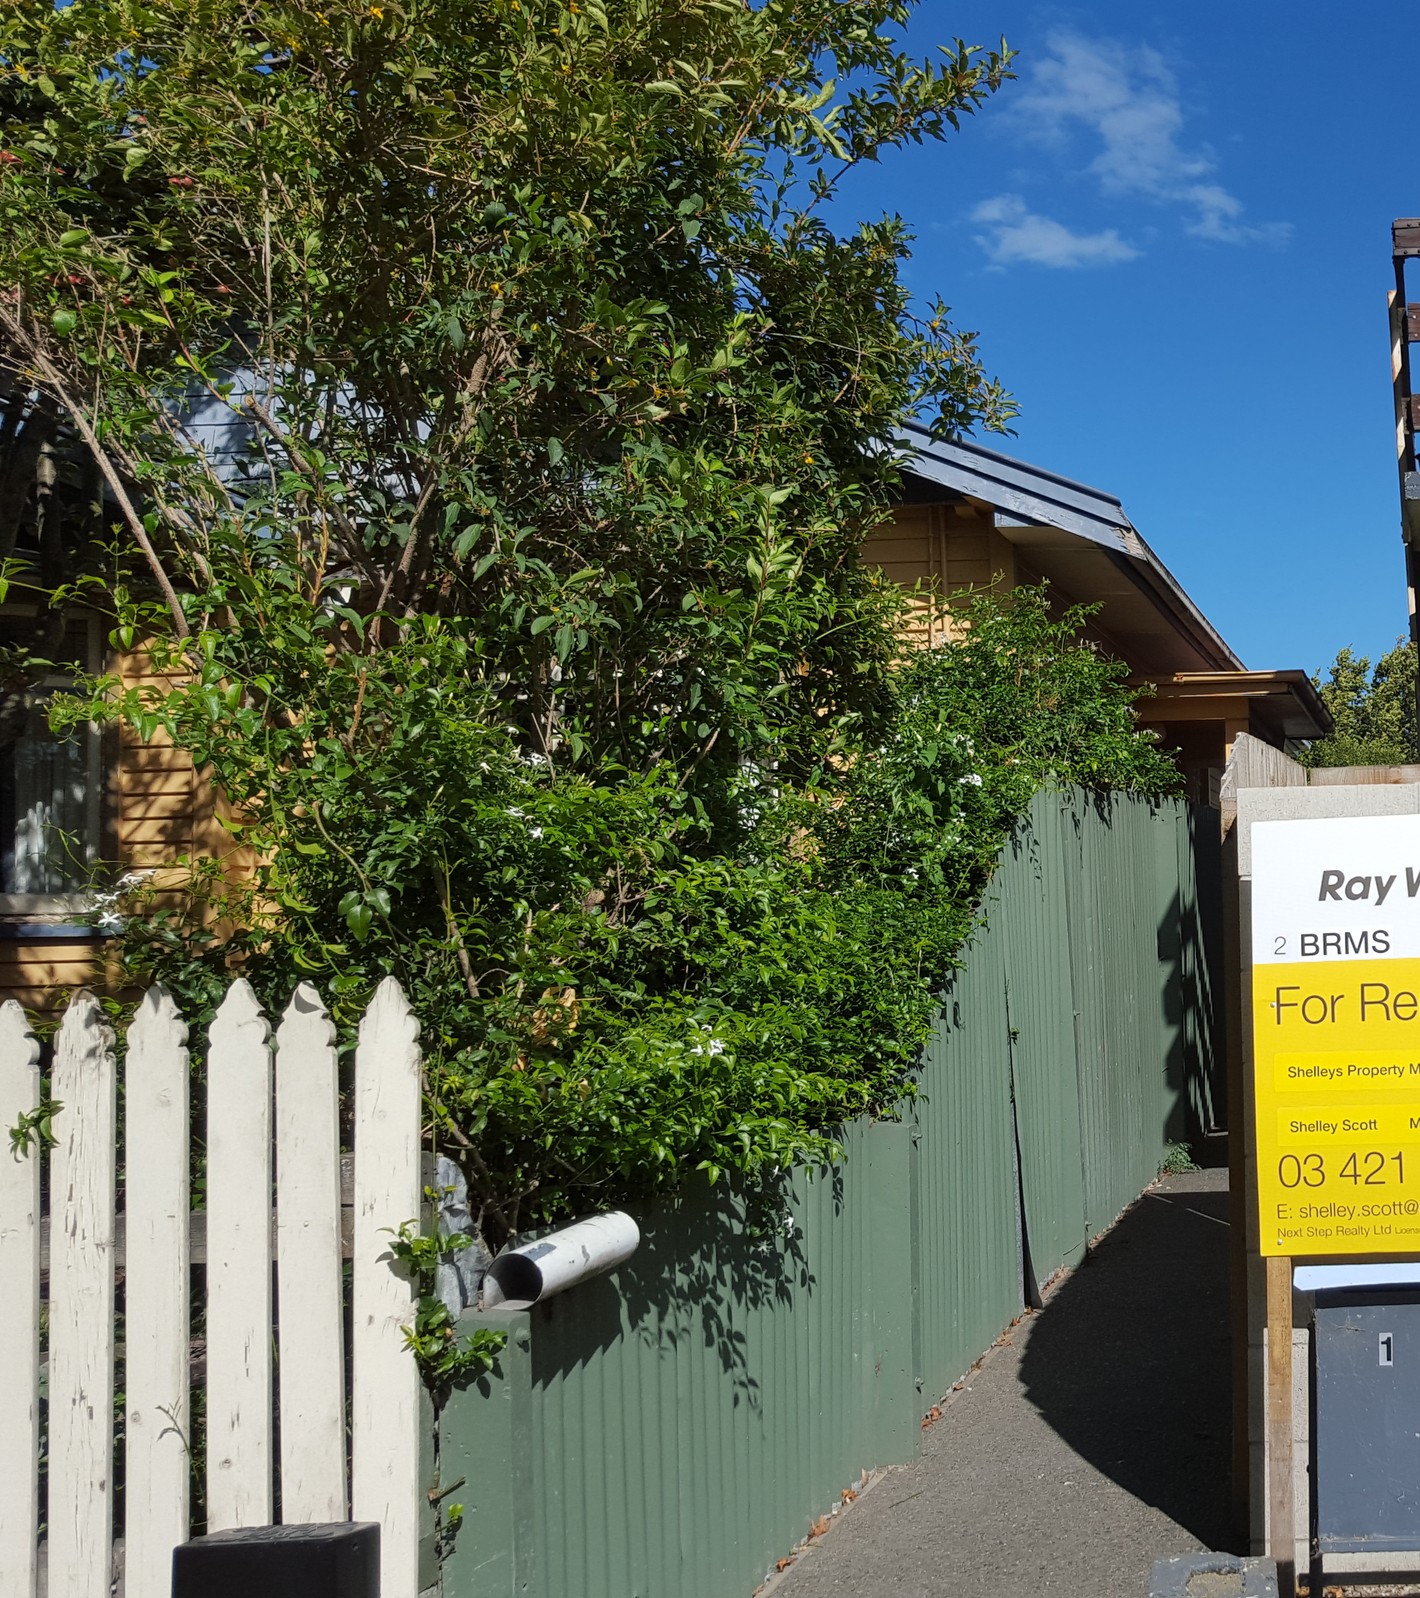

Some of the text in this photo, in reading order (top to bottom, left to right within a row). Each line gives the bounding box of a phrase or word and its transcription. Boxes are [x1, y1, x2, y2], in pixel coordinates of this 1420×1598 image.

[1318, 869, 1397, 906] Ray
[1273, 929, 1391, 957] 2 BRMS
[1275, 986, 1345, 1026] For
[1287, 1065, 1343, 1079] Shelleys
[1347, 1063, 1405, 1078] Property
[1289, 1118, 1378, 1134] Shelley Scott
[1278, 1154, 1326, 1189] 03
[1339, 1151, 1404, 1186] 421
[1276, 1203, 1293, 1219] E:
[1277, 1227, 1303, 1238] Next
[1306, 1226, 1333, 1239] Step
[1335, 1225, 1370, 1238] Realty
[1373, 1224, 1392, 1235] Ltd
[1380, 1336, 1392, 1362] 1
